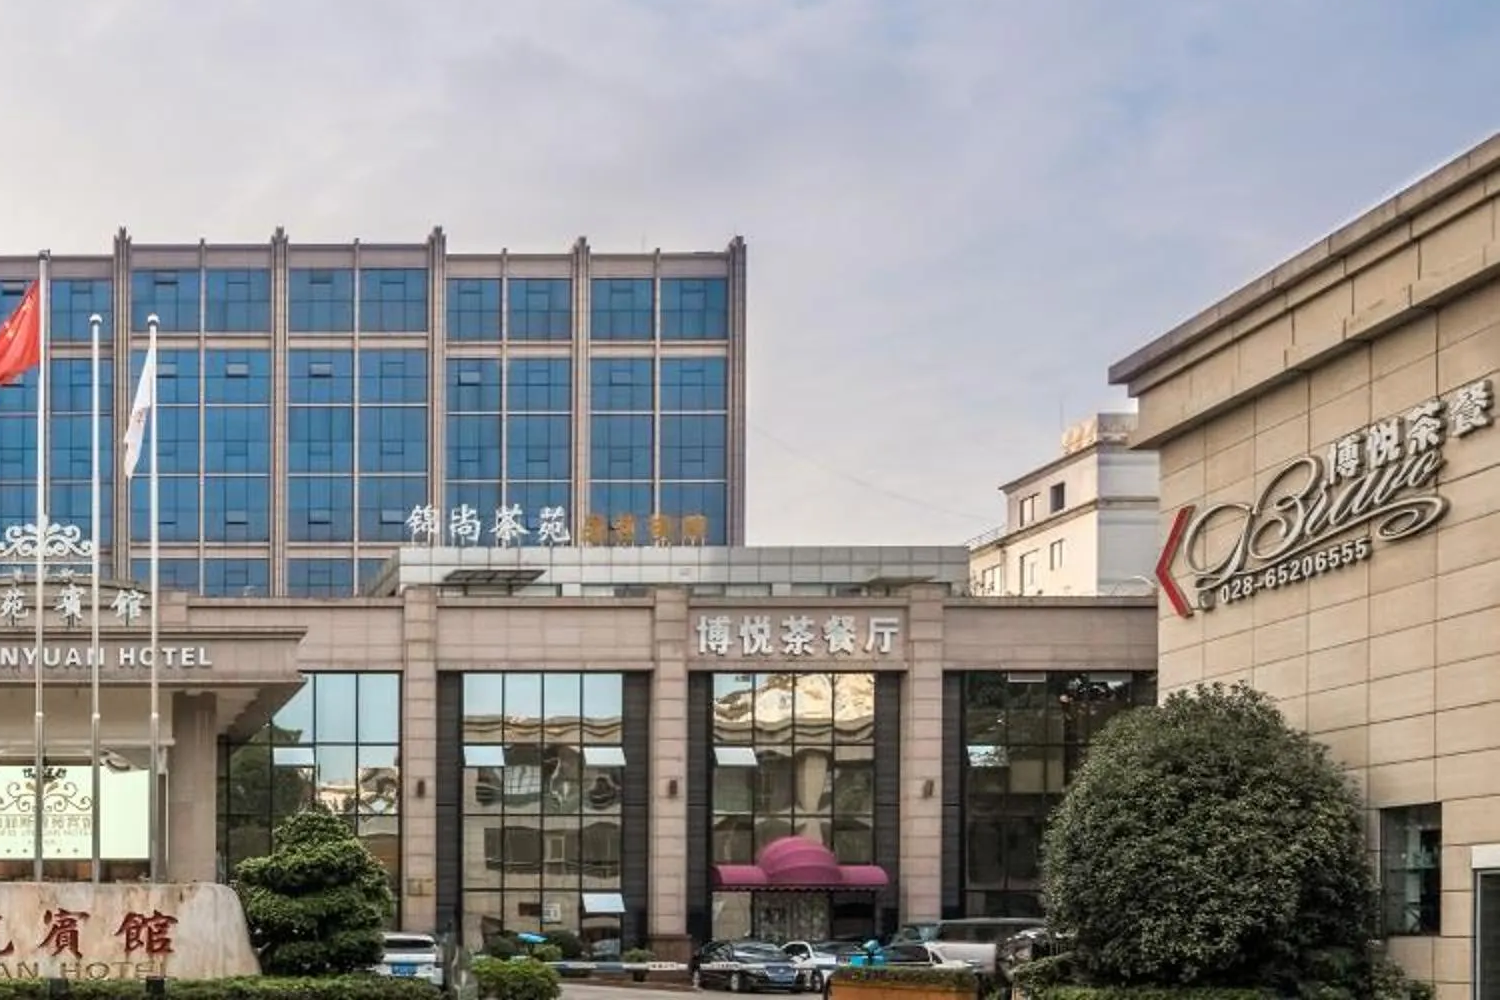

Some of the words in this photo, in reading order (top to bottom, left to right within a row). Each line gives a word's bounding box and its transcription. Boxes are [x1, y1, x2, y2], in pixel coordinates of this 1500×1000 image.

[1326, 378, 1494, 484] 博悦茶餐
[1219, 537, 1373, 604] 028-65206555
[696, 615, 900, 656] 博悦茶餐厅
[118, 646, 214, 667] HOTEL
[58, 961, 170, 980] HOTEL
